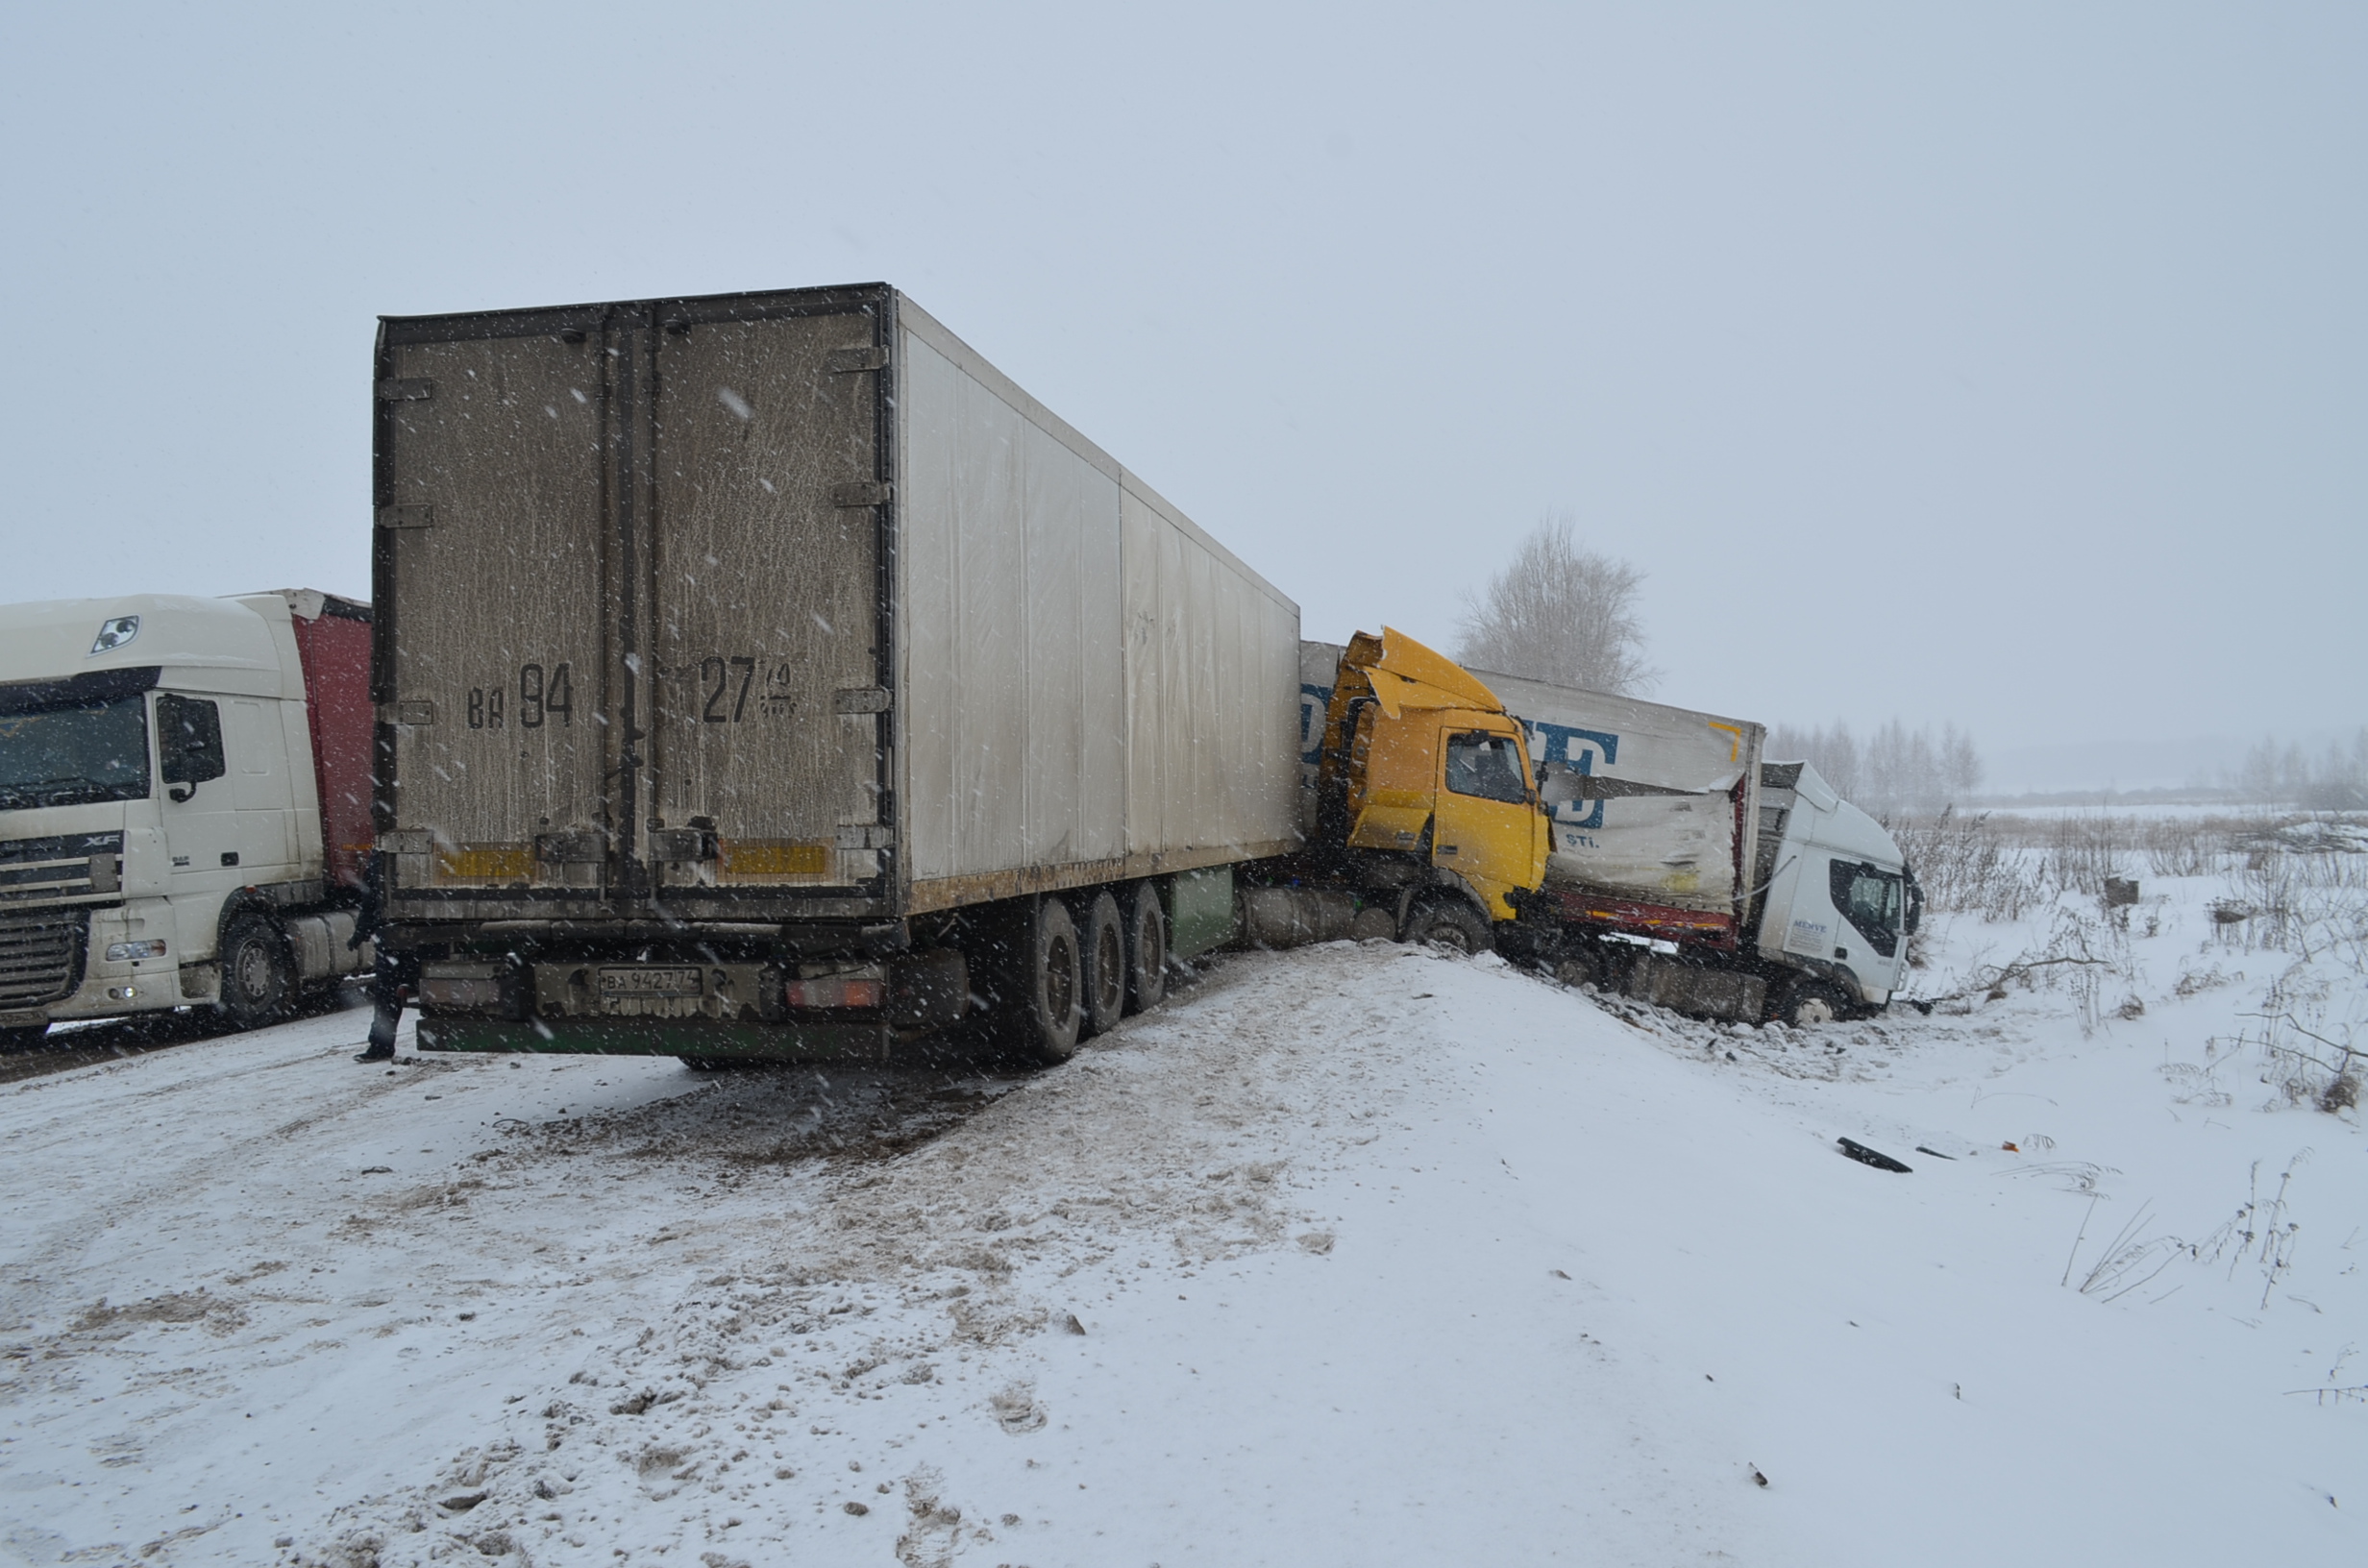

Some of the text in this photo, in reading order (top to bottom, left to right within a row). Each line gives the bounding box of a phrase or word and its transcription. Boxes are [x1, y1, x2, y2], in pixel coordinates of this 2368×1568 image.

[520, 663, 574, 728] 94
[701, 655, 756, 723] 27
[82, 835, 120, 847] XF
[607, 975, 627, 989] BA
[631, 971, 674, 990] 9427
